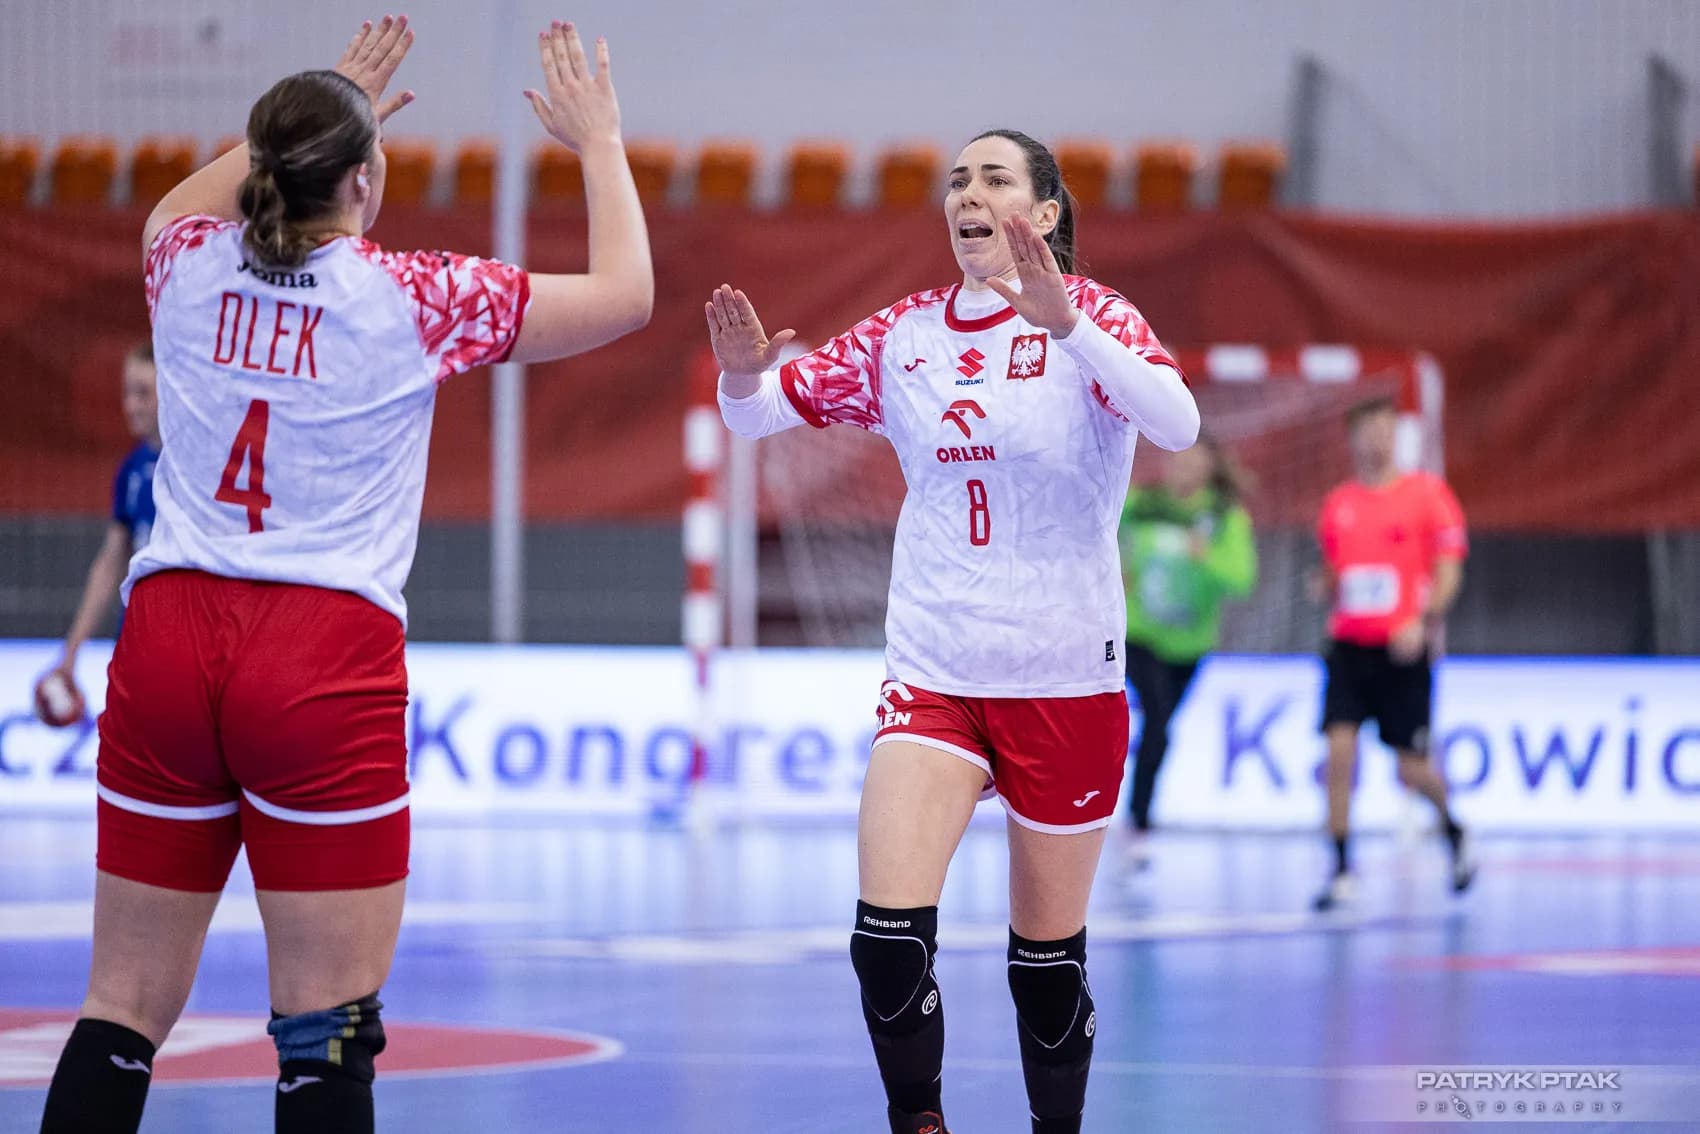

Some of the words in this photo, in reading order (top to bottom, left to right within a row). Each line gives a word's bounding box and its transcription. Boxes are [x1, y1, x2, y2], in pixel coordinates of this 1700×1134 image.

[954, 378, 984, 386] SUZUKI
[214, 398, 272, 534] 4
[936, 446, 996, 463] ORLEN
[966, 479, 991, 546] 8
[1221, 694, 1700, 795] Kowic
